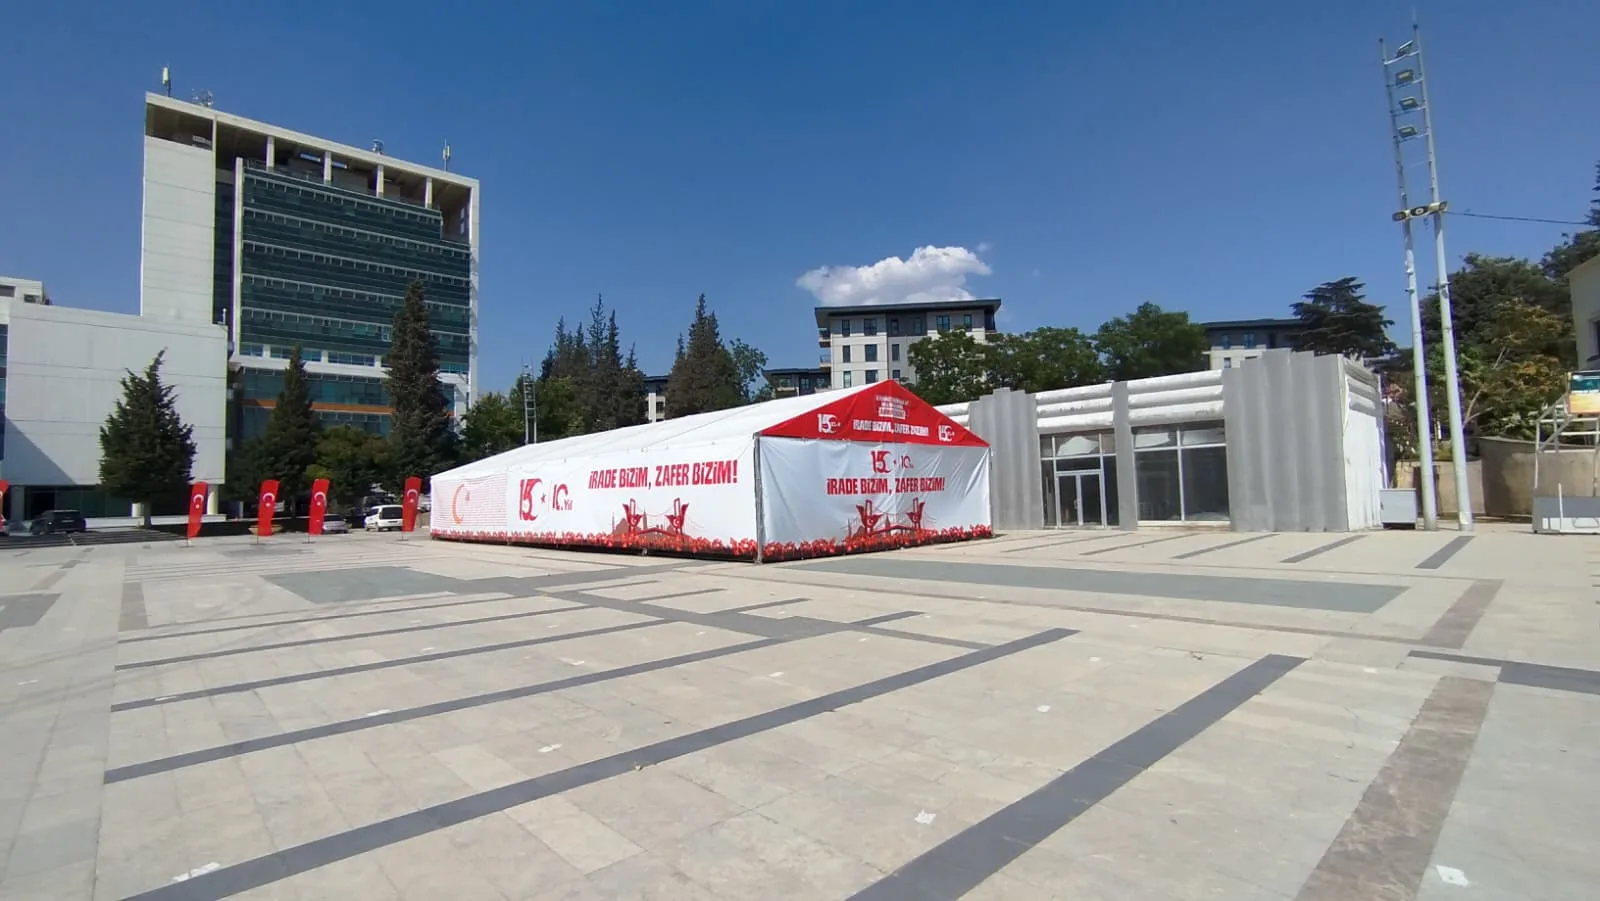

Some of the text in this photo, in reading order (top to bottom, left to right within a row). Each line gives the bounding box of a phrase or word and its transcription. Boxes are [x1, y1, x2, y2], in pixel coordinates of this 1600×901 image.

[655, 463, 690, 487] ZAFER
[692, 459, 738, 485] BİZİM!
[895, 477, 919, 493] ZAFER
